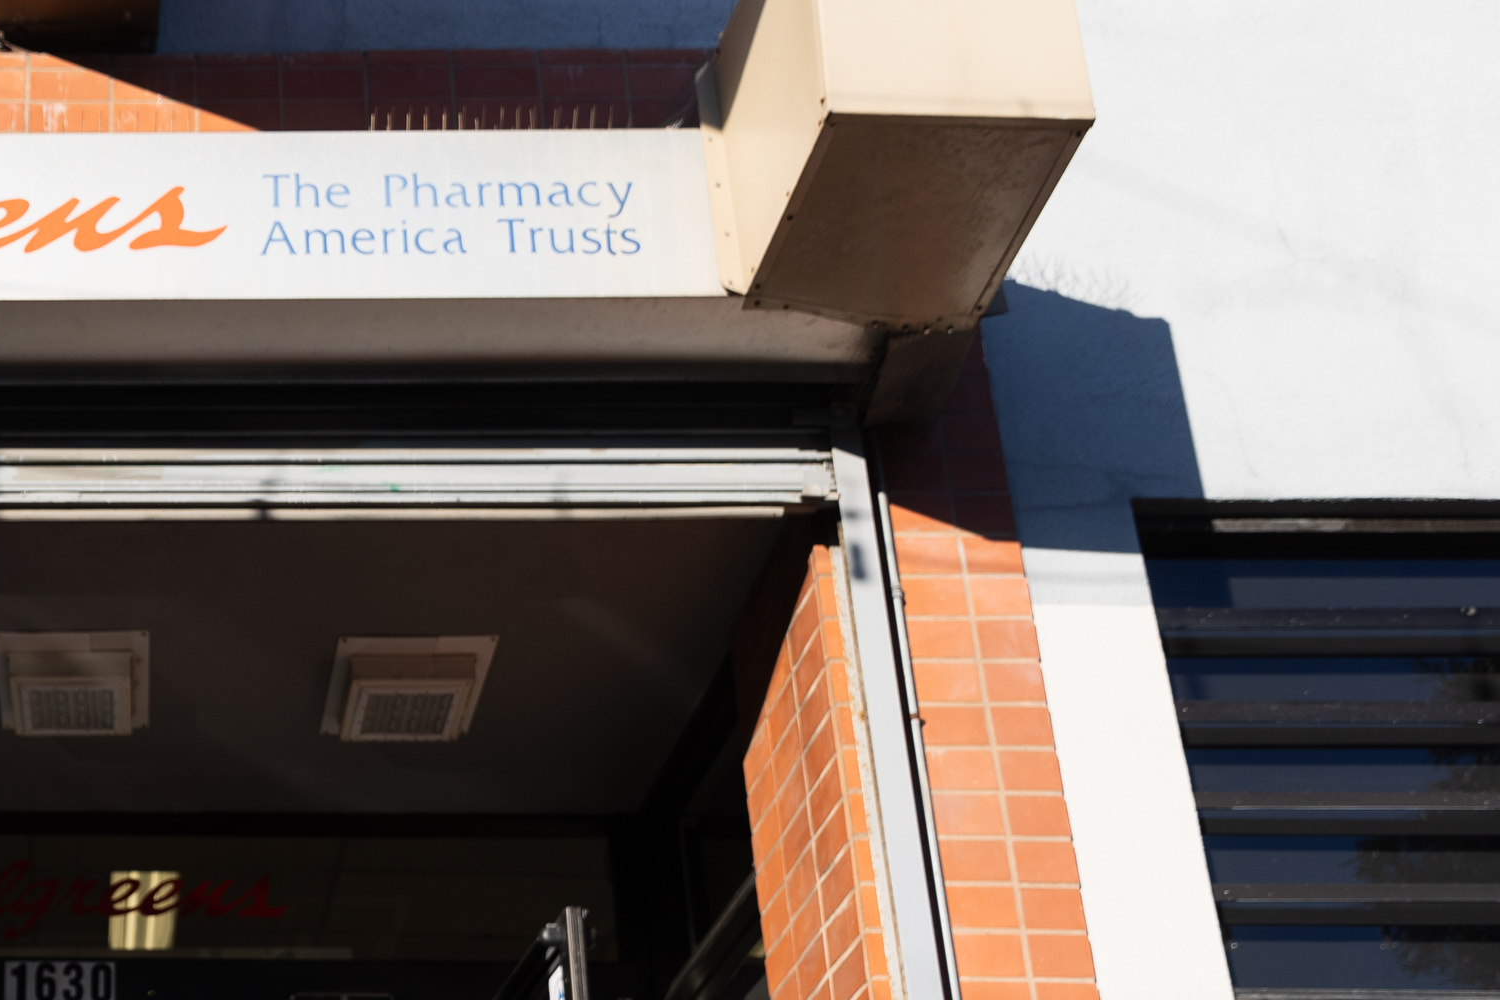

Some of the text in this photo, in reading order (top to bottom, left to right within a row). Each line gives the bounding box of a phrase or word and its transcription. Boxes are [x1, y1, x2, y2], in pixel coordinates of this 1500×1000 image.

[262, 172, 634, 218] The Pharmacy
[260, 218, 642, 256] America Trusts
